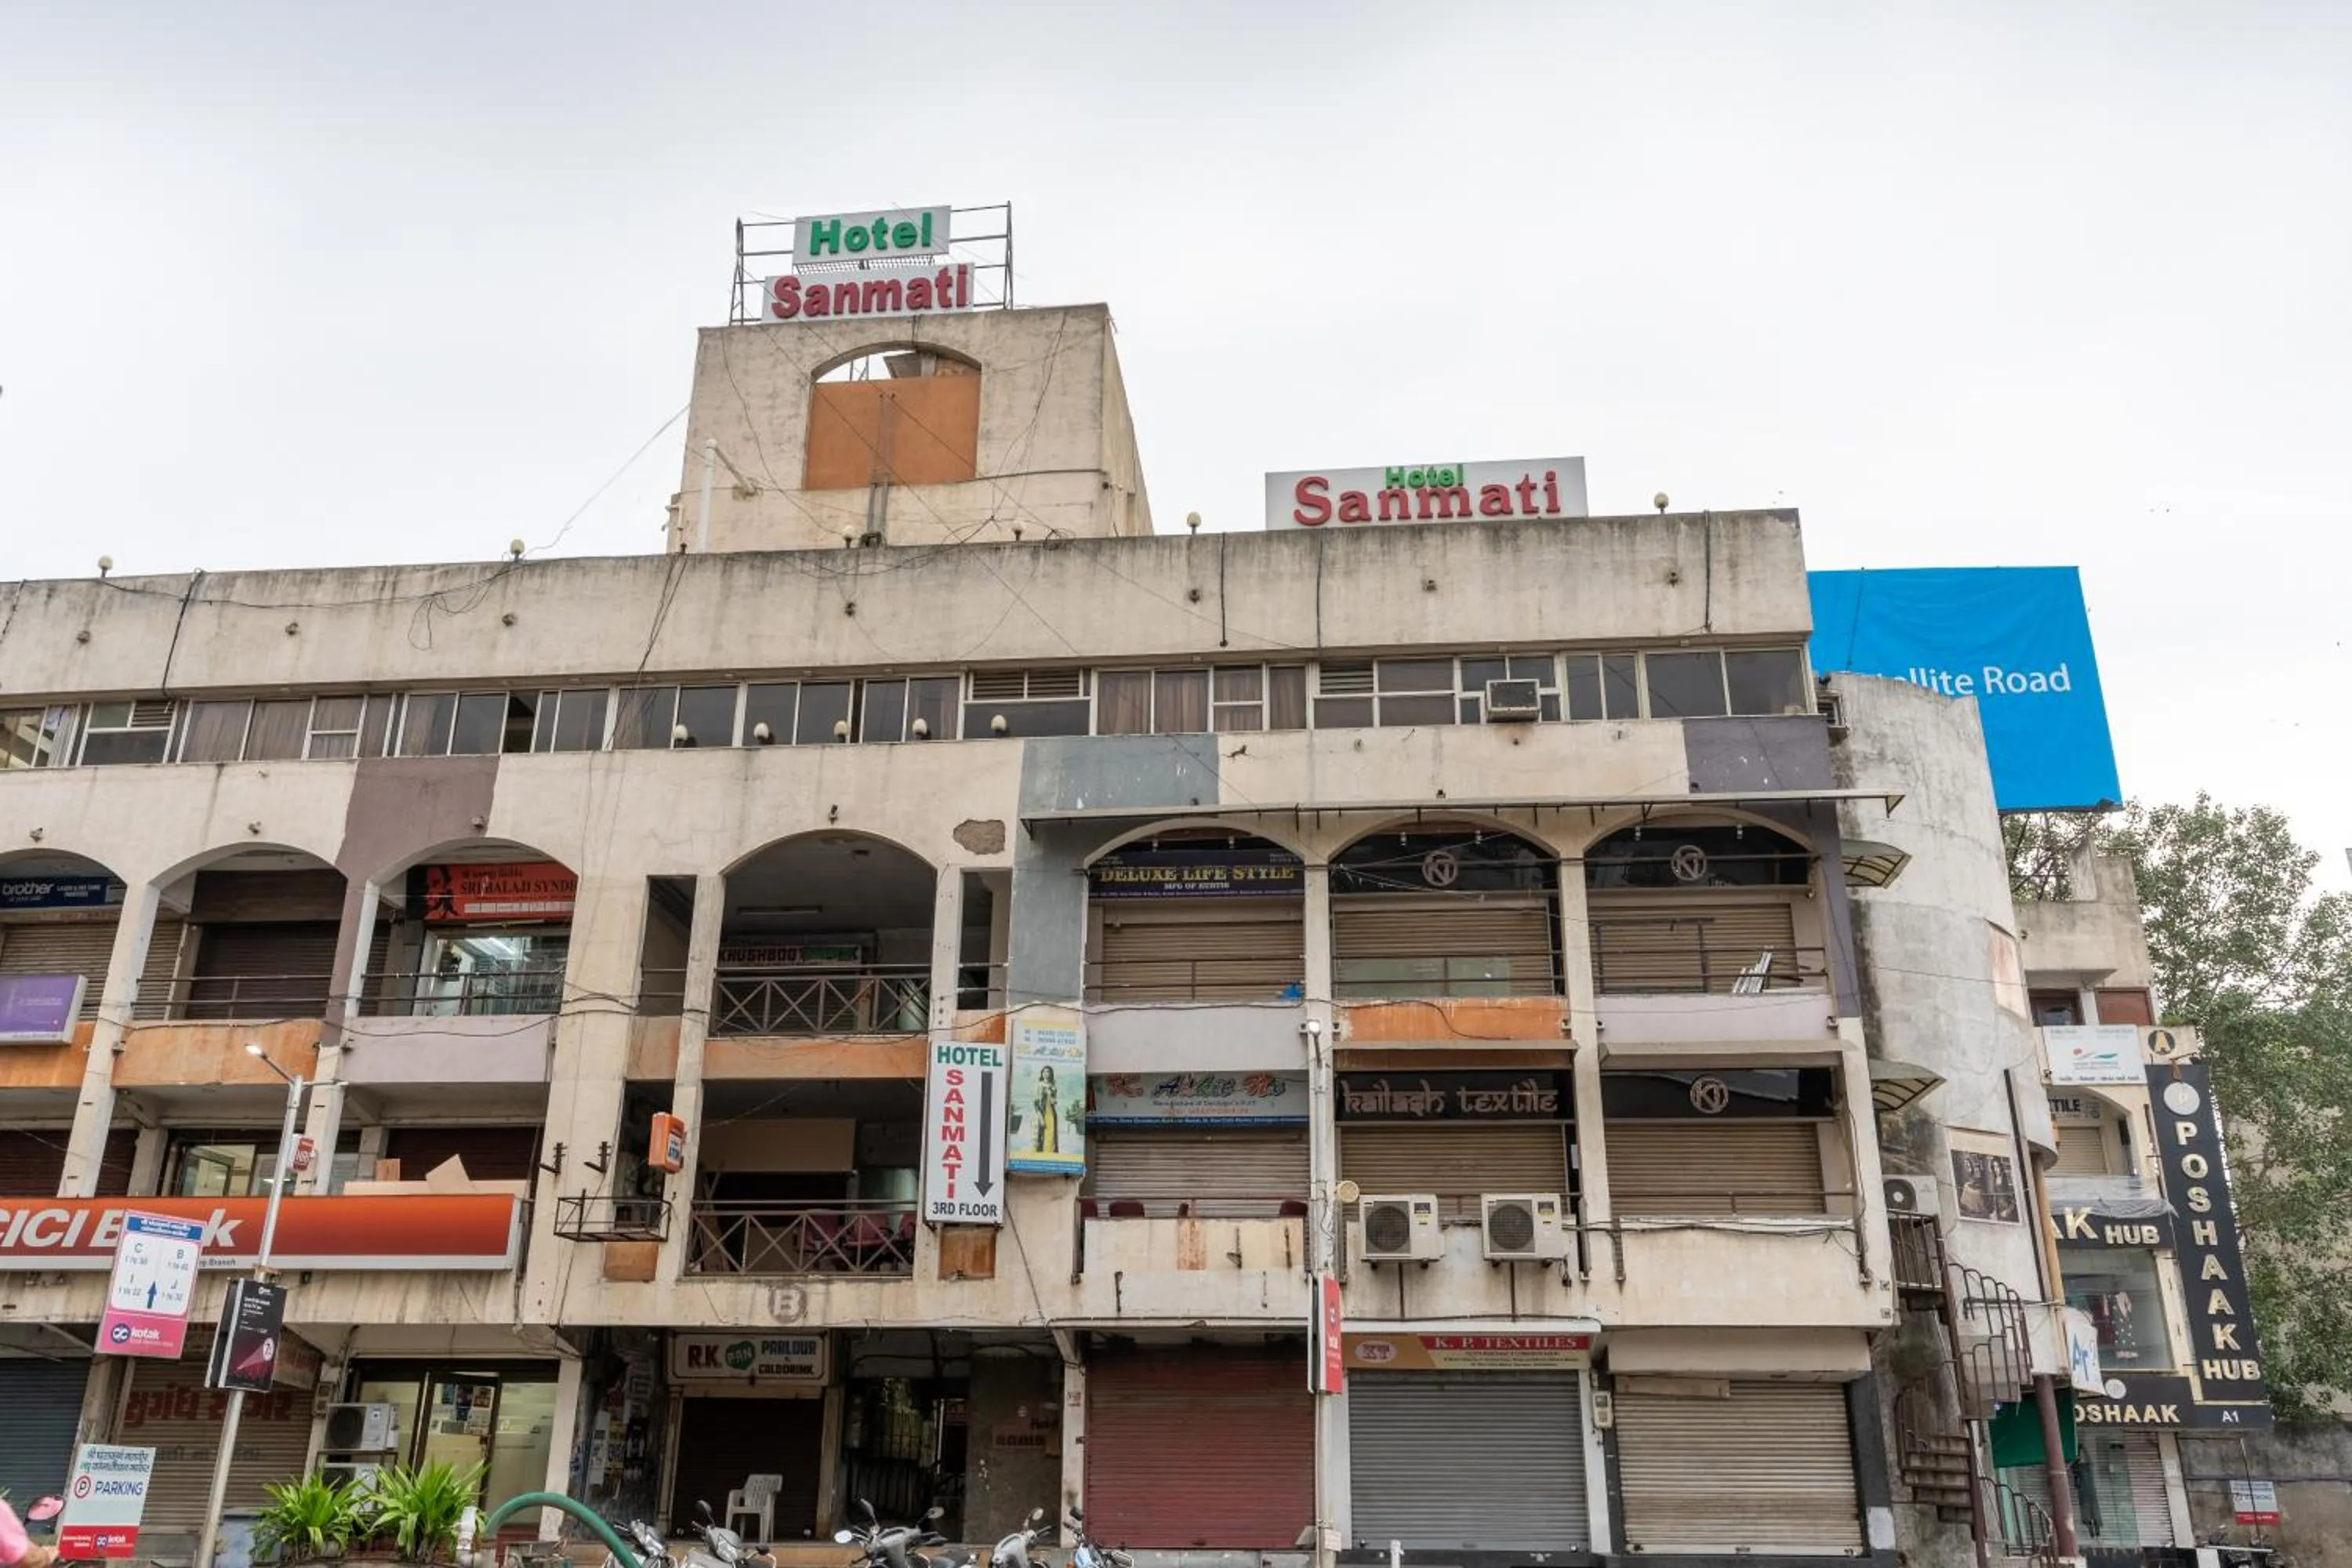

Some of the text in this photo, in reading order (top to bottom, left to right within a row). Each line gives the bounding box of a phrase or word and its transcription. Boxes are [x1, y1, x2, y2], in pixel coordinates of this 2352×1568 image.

[810, 212, 932, 256] Hotel
[771, 263, 969, 319] Sanmati
[1385, 464, 1465, 488] Hotel
[1294, 470, 1561, 526] Sanmati
[1876, 662, 2071, 695] llite Road
[1100, 864, 1294, 883] DELUXE LIFE STYLE
[2, 880, 55, 895] brother
[937, 1046, 1004, 1067] HOTEL
[1457, 1079, 1559, 1113] textile
[942, 1069, 965, 1199] SANMATI
[932, 1202, 998, 1217] 3RD FLOOR
[0, 1208, 90, 1248] ICI
[2104, 1225, 2160, 1244] HUB
[2175, 1121, 2241, 1351] POSHAAK
[134, 1243, 143, 1254] C
[774, 1288, 800, 1316] B
[130, 1327, 160, 1340] kotak
[1436, 1337, 1454, 1348] K.
[1479, 1335, 1577, 1349] TEXTILES
[761, 1340, 816, 1356] PARLOUR
[2201, 1359, 2261, 1381] HUB
[2074, 1404, 2180, 1423] OSHAAK
[2221, 1410, 2239, 1423] A1
[95, 1481, 143, 1495] PARKING
